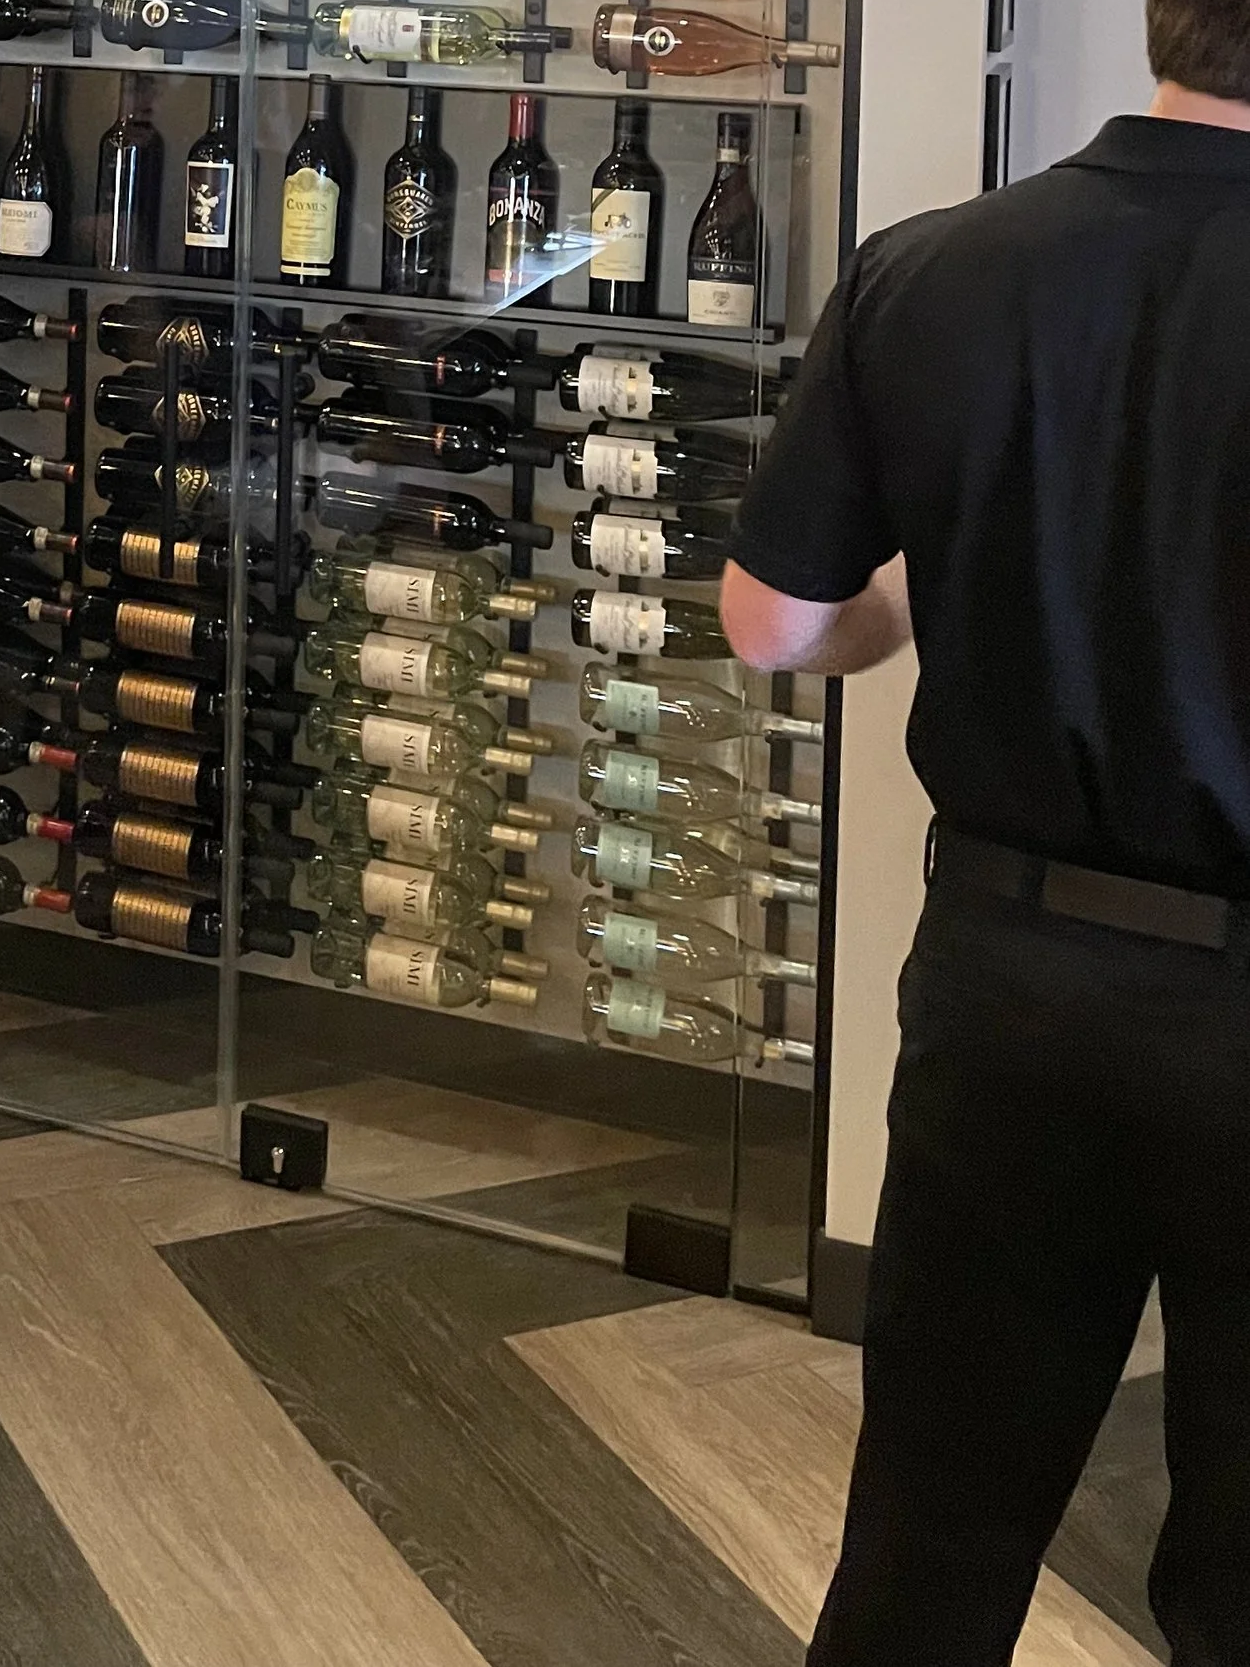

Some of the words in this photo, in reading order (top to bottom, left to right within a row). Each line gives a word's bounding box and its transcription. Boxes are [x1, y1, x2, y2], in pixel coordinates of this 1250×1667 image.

[286, 198, 328, 212] CAYMUS
[489, 196, 546, 228] BONANZA
[407, 578, 420, 613] SIMI
[401, 646, 416, 683] SIMI
[402, 733, 416, 771] SIMI
[408, 804, 423, 840] SIMI
[403, 878, 418, 914] SIMI
[407, 950, 424, 987] SIMI
